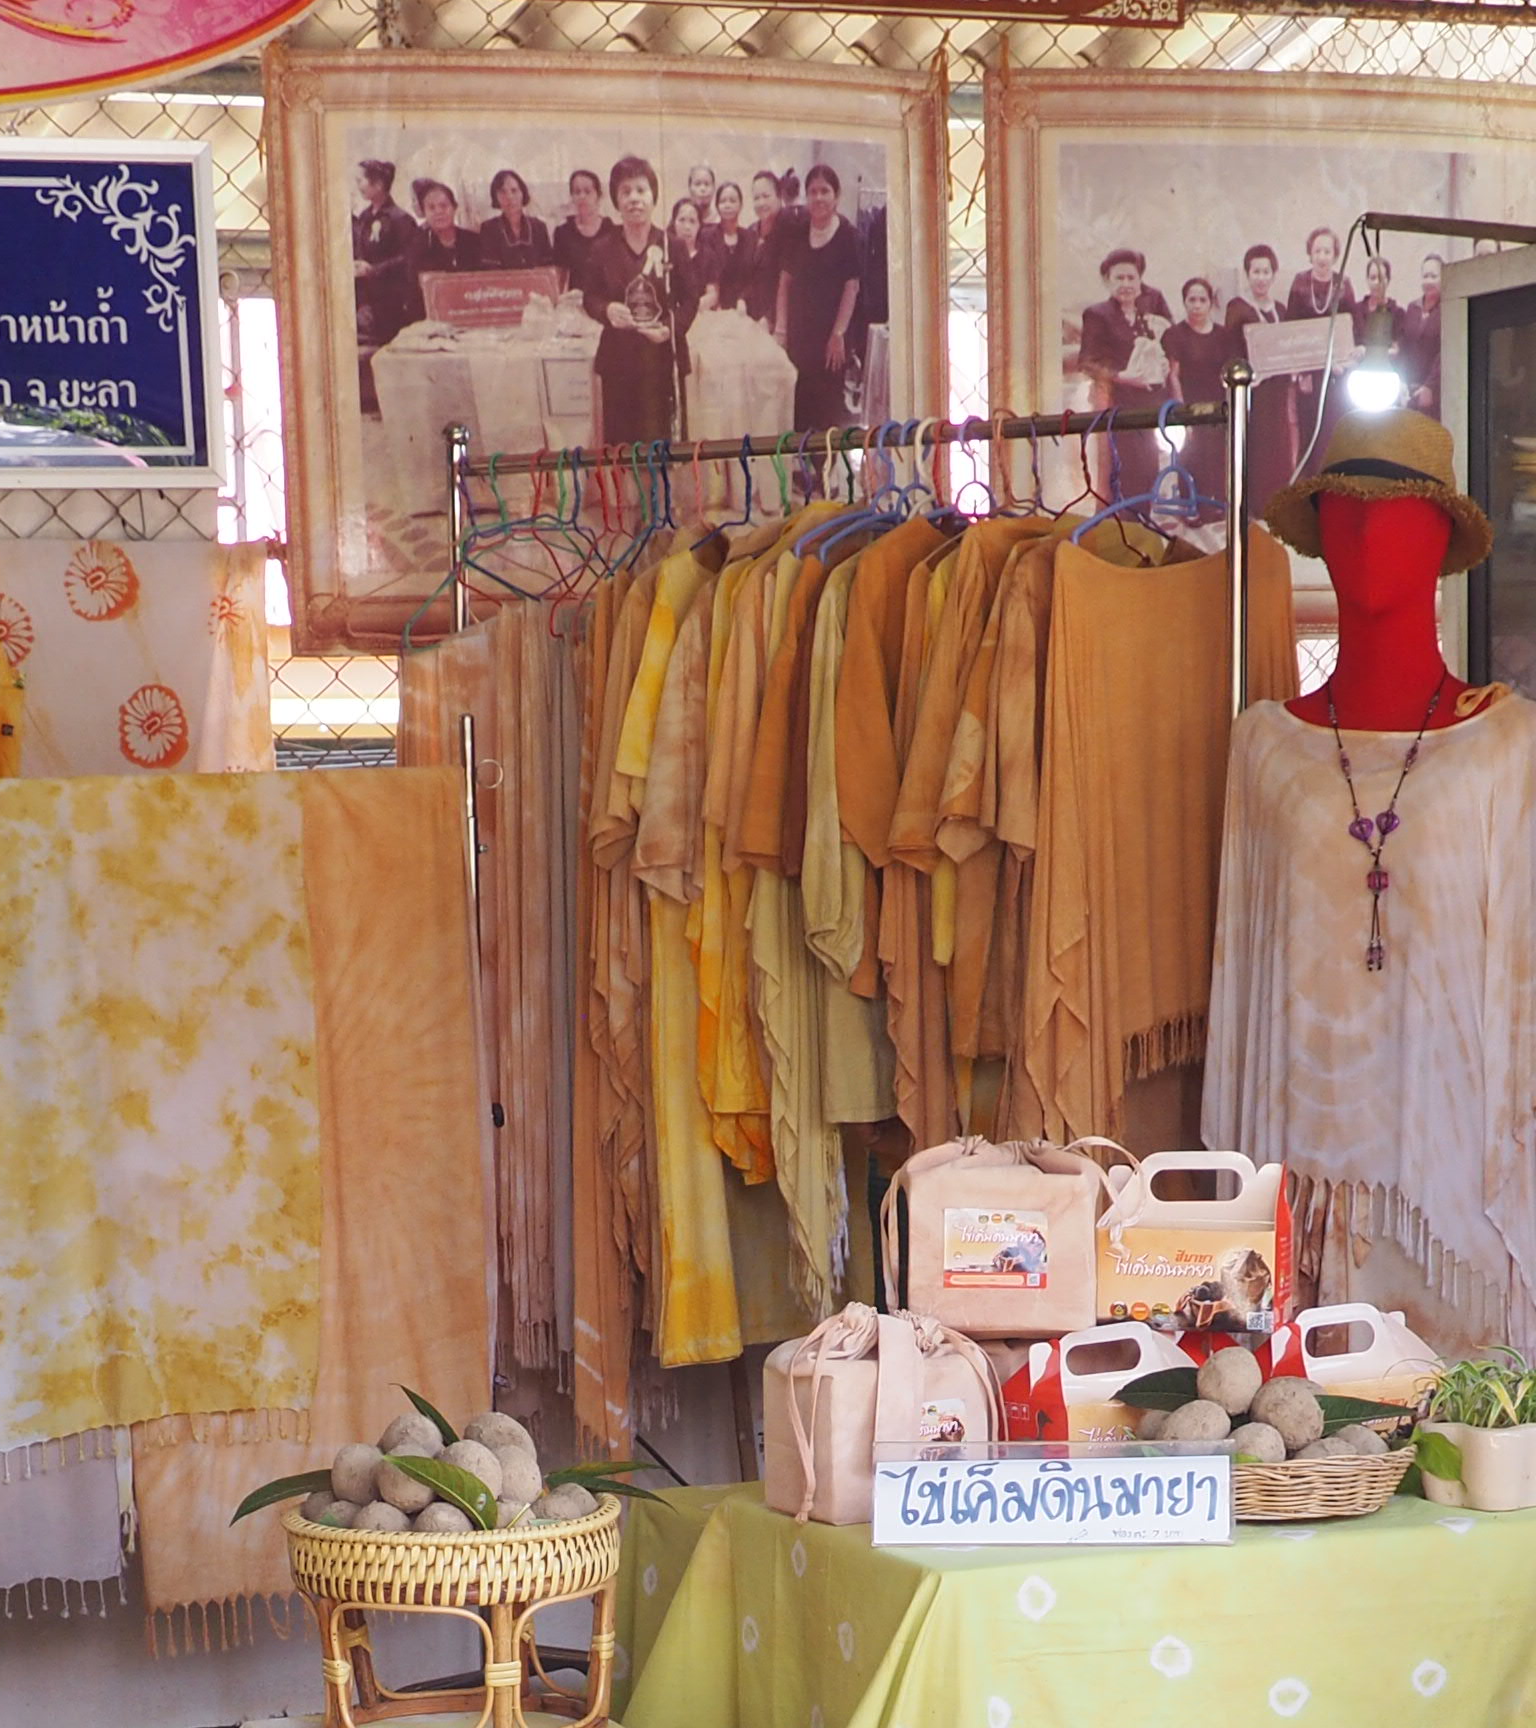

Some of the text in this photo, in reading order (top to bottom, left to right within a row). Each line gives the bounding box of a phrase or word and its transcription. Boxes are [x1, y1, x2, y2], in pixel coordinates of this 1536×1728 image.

[28, 378, 138, 409] จ.ยะลา
[1105, 1251, 1214, 1278] ไข่เค็มดินมายา
[879, 1460, 1220, 1527] ไข่เค็มดินมายา
